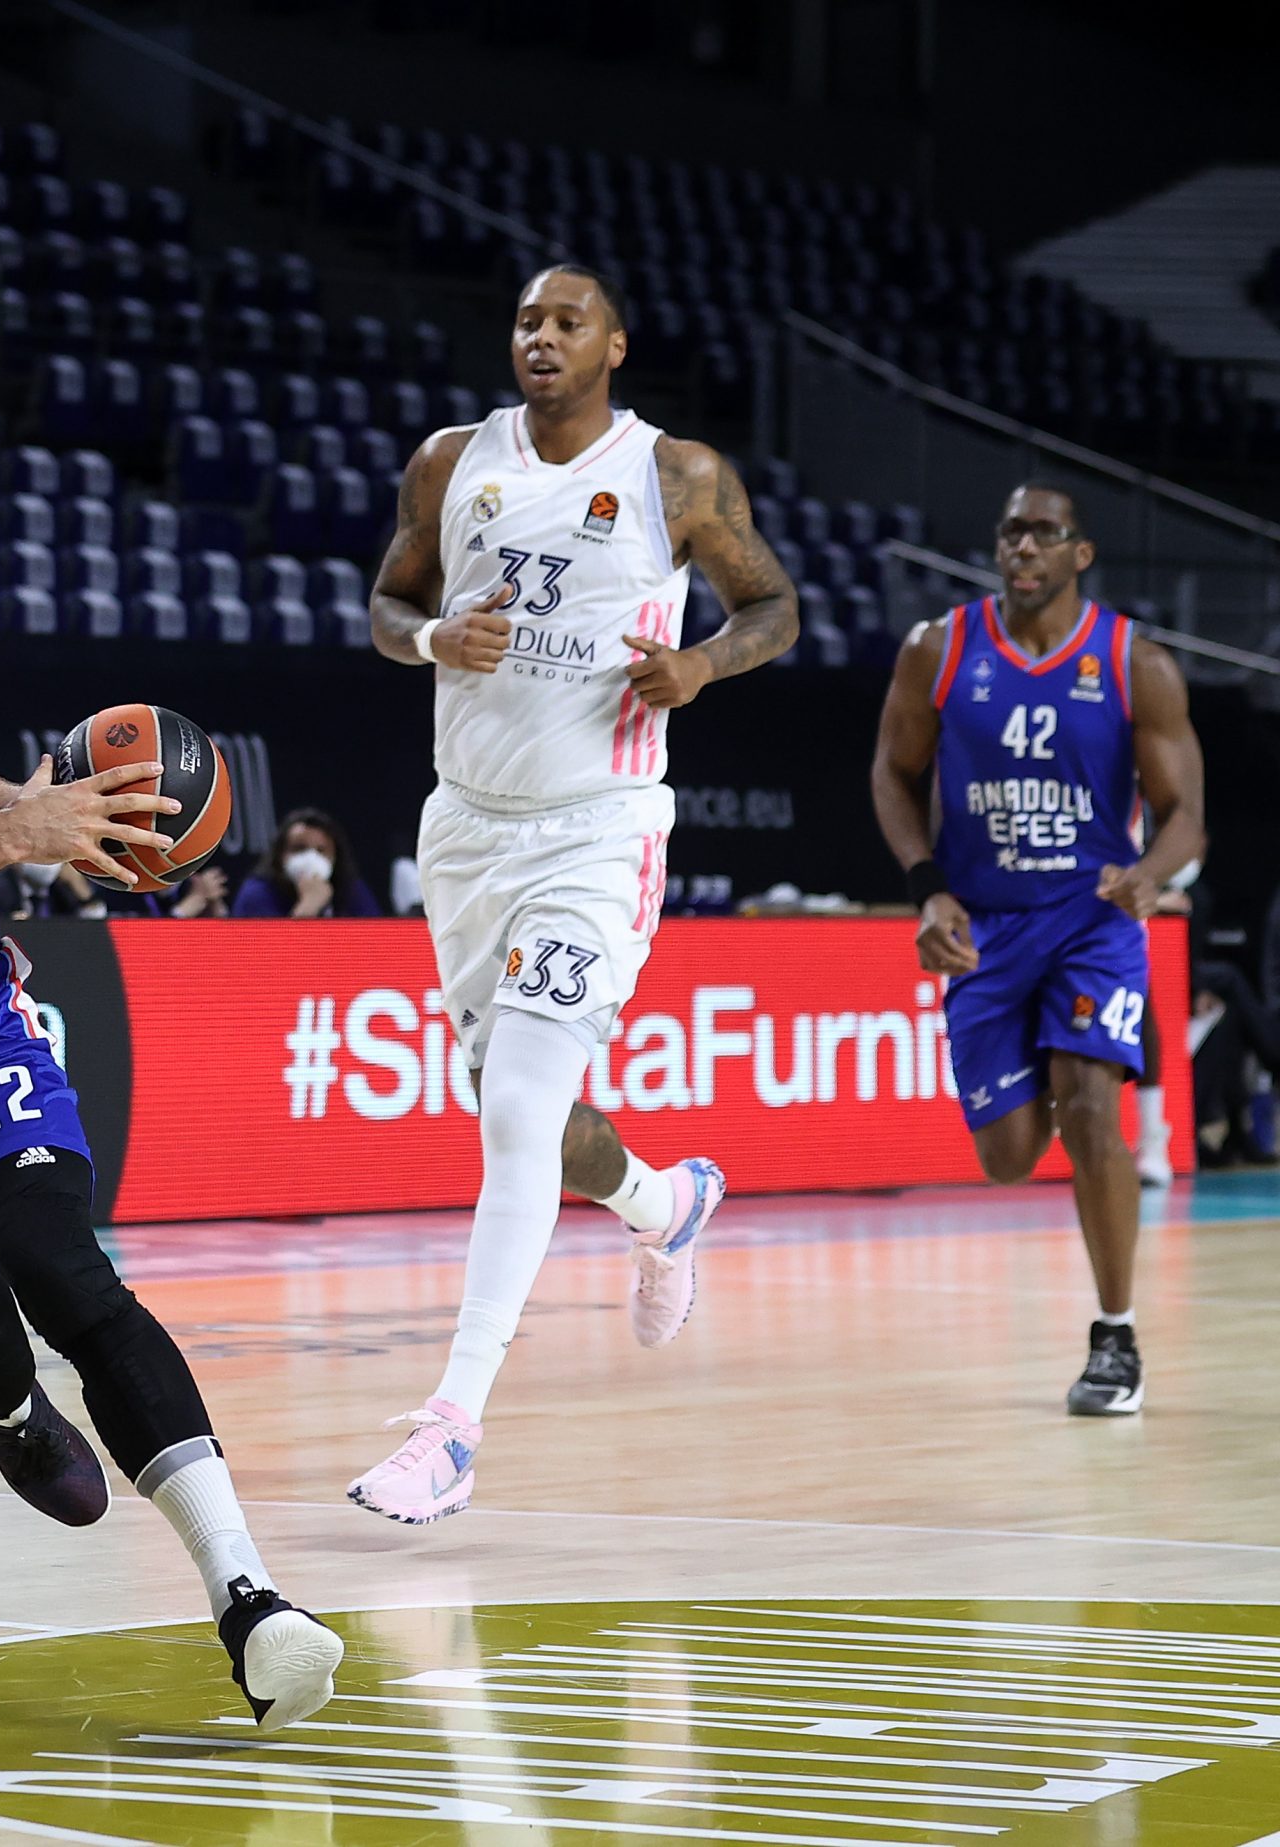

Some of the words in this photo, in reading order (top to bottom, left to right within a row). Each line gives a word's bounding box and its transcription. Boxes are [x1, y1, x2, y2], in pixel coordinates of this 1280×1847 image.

[486, 547, 573, 616] 33
[514, 627, 596, 663] DIUM
[513, 663, 592, 685] GROUP
[1000, 704, 1059, 760] 42
[966, 777, 1095, 822] ANADOLU
[988, 812, 1078, 848] EFES
[518, 938, 602, 1006] 33
[1099, 986, 1145, 1046] 42
[15, 1154, 57, 1169] adidas
